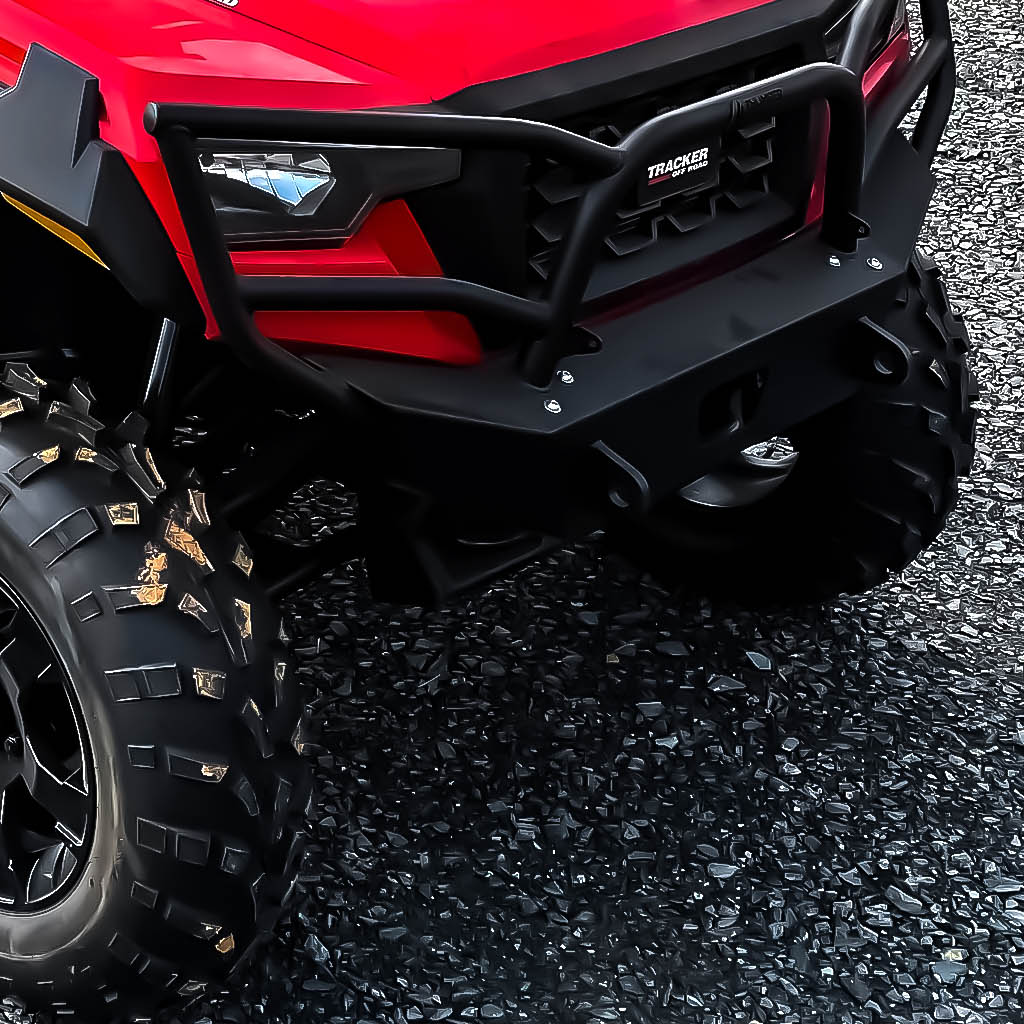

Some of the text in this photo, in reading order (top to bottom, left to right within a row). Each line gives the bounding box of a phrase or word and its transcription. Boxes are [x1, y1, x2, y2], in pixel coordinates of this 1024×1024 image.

[648, 147, 709, 179] TRACKER
[671, 160, 709, 178] OFF ROAD
